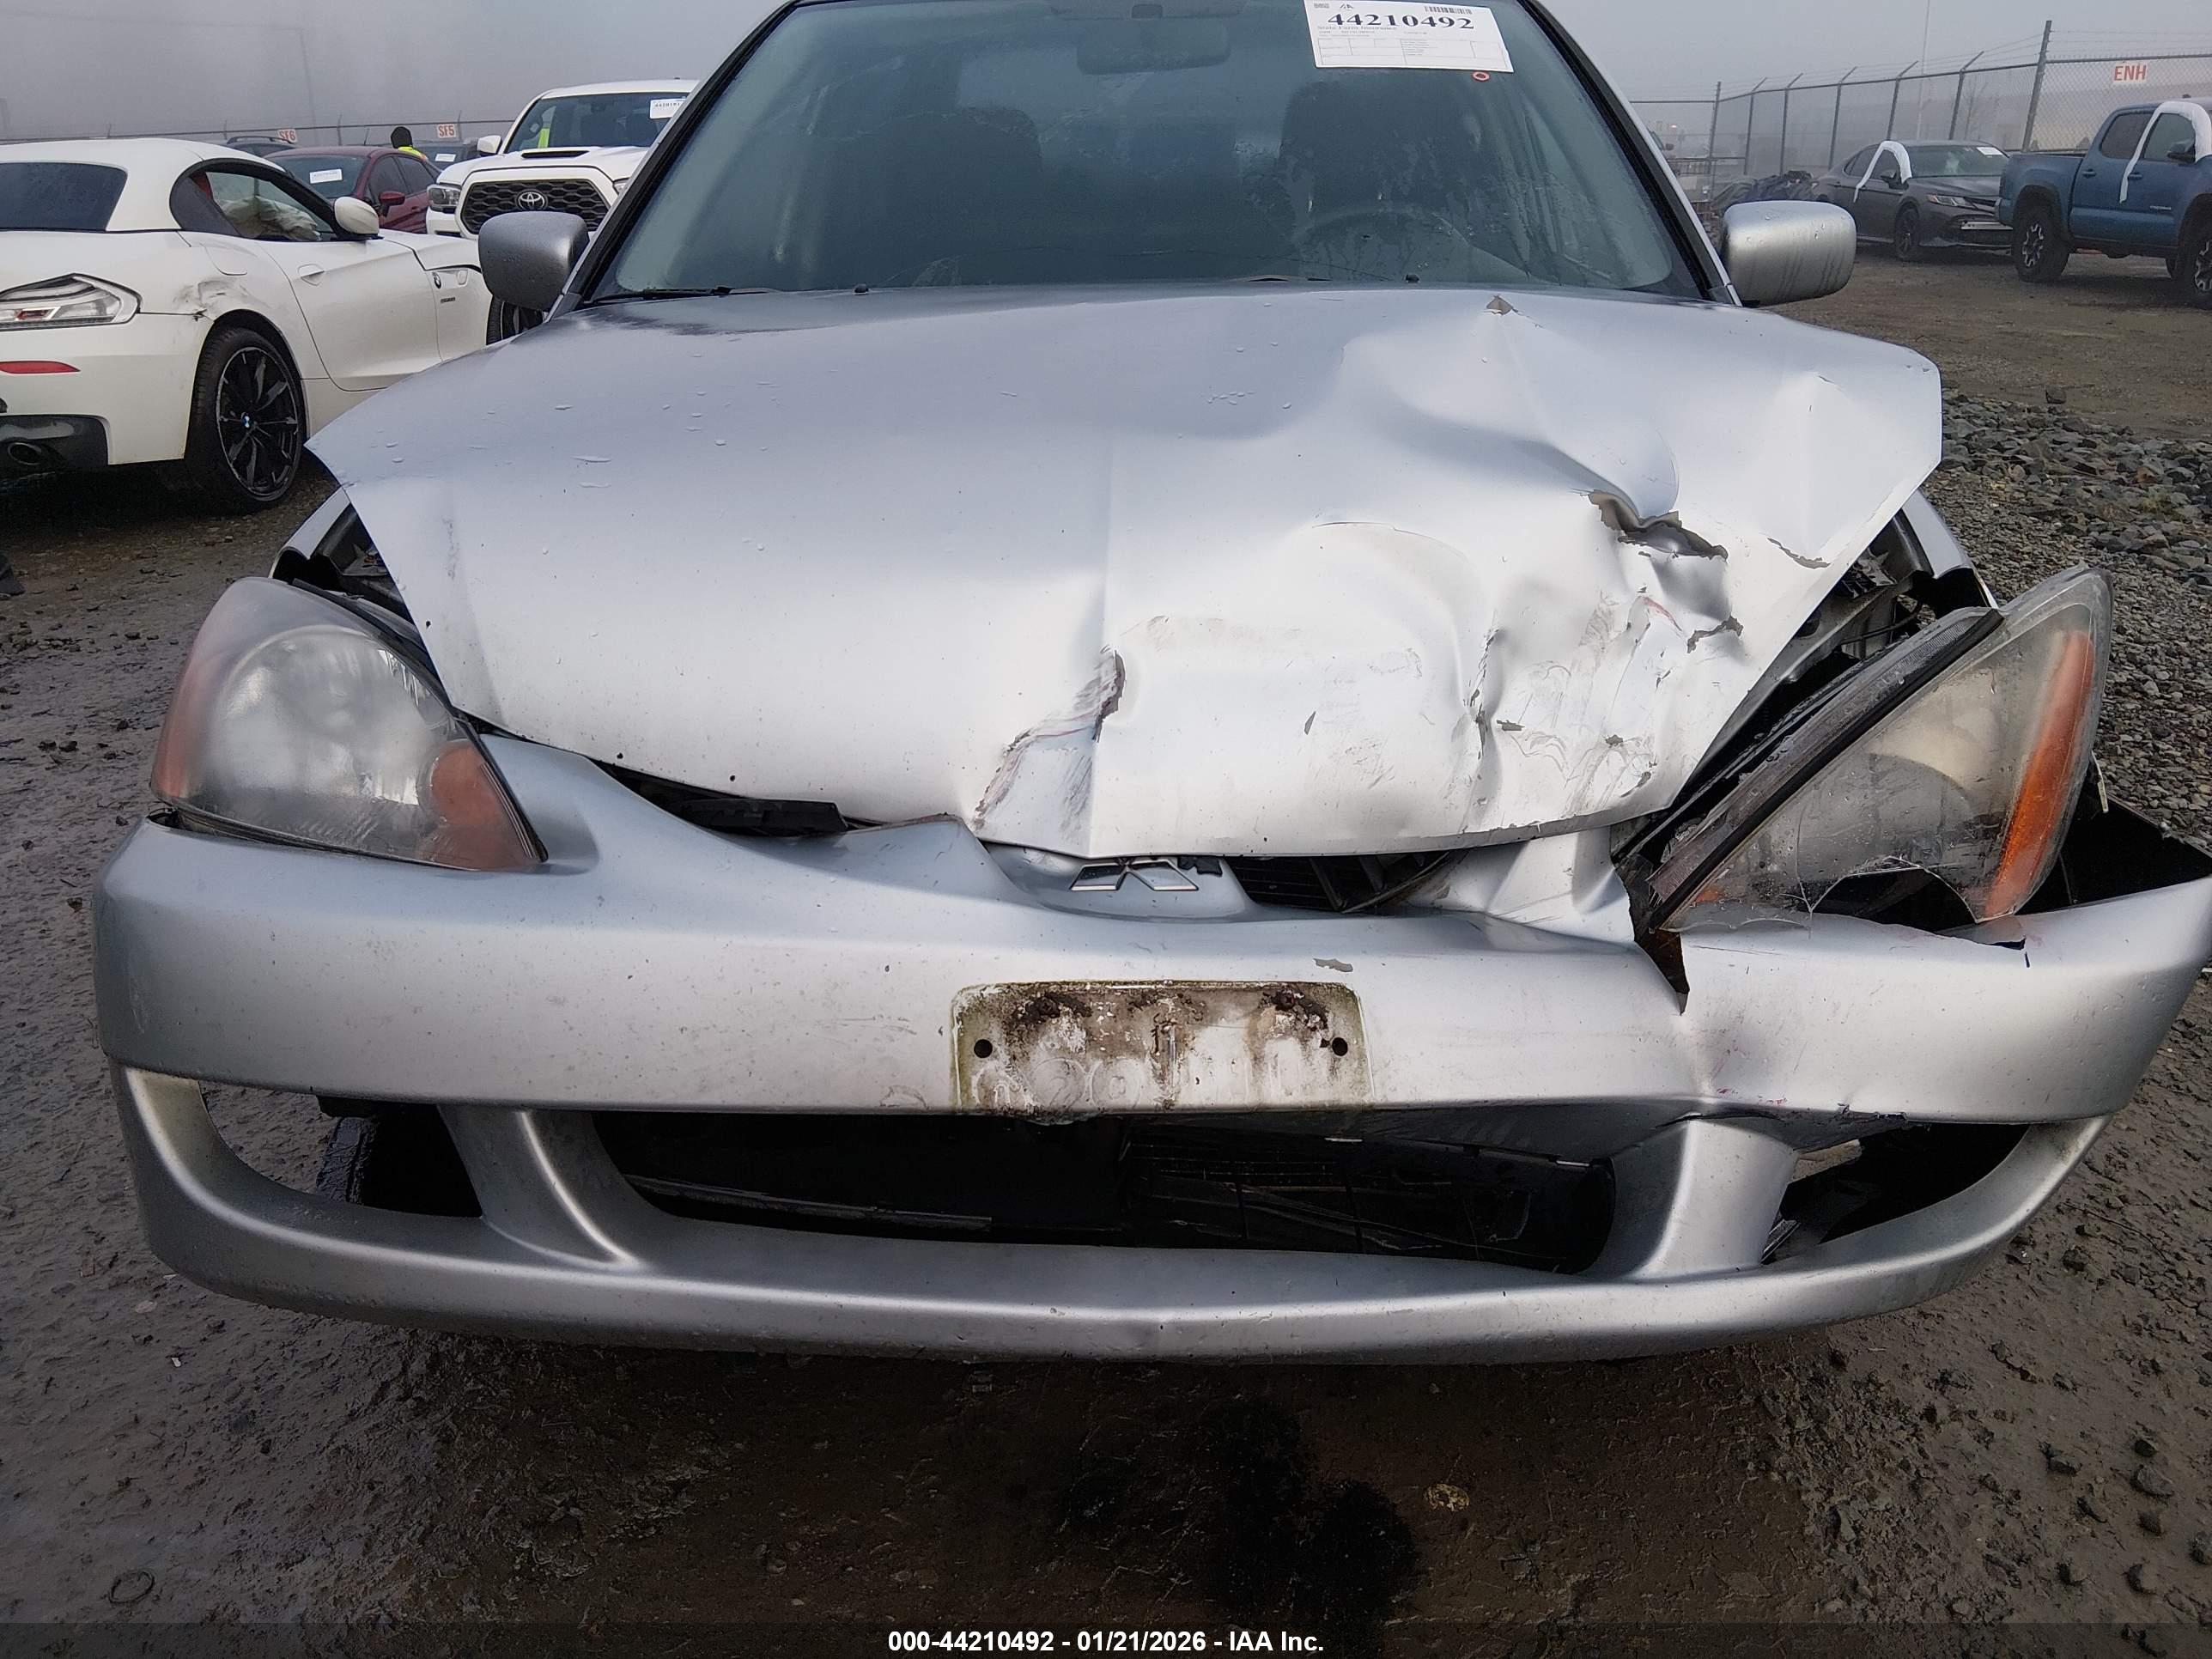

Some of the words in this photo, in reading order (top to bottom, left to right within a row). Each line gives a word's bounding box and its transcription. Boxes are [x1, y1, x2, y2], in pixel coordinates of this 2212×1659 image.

[1328, 13, 1474, 29] 44210492
[2114, 64, 2147, 82] ENH
[438, 125, 455, 137] SF5
